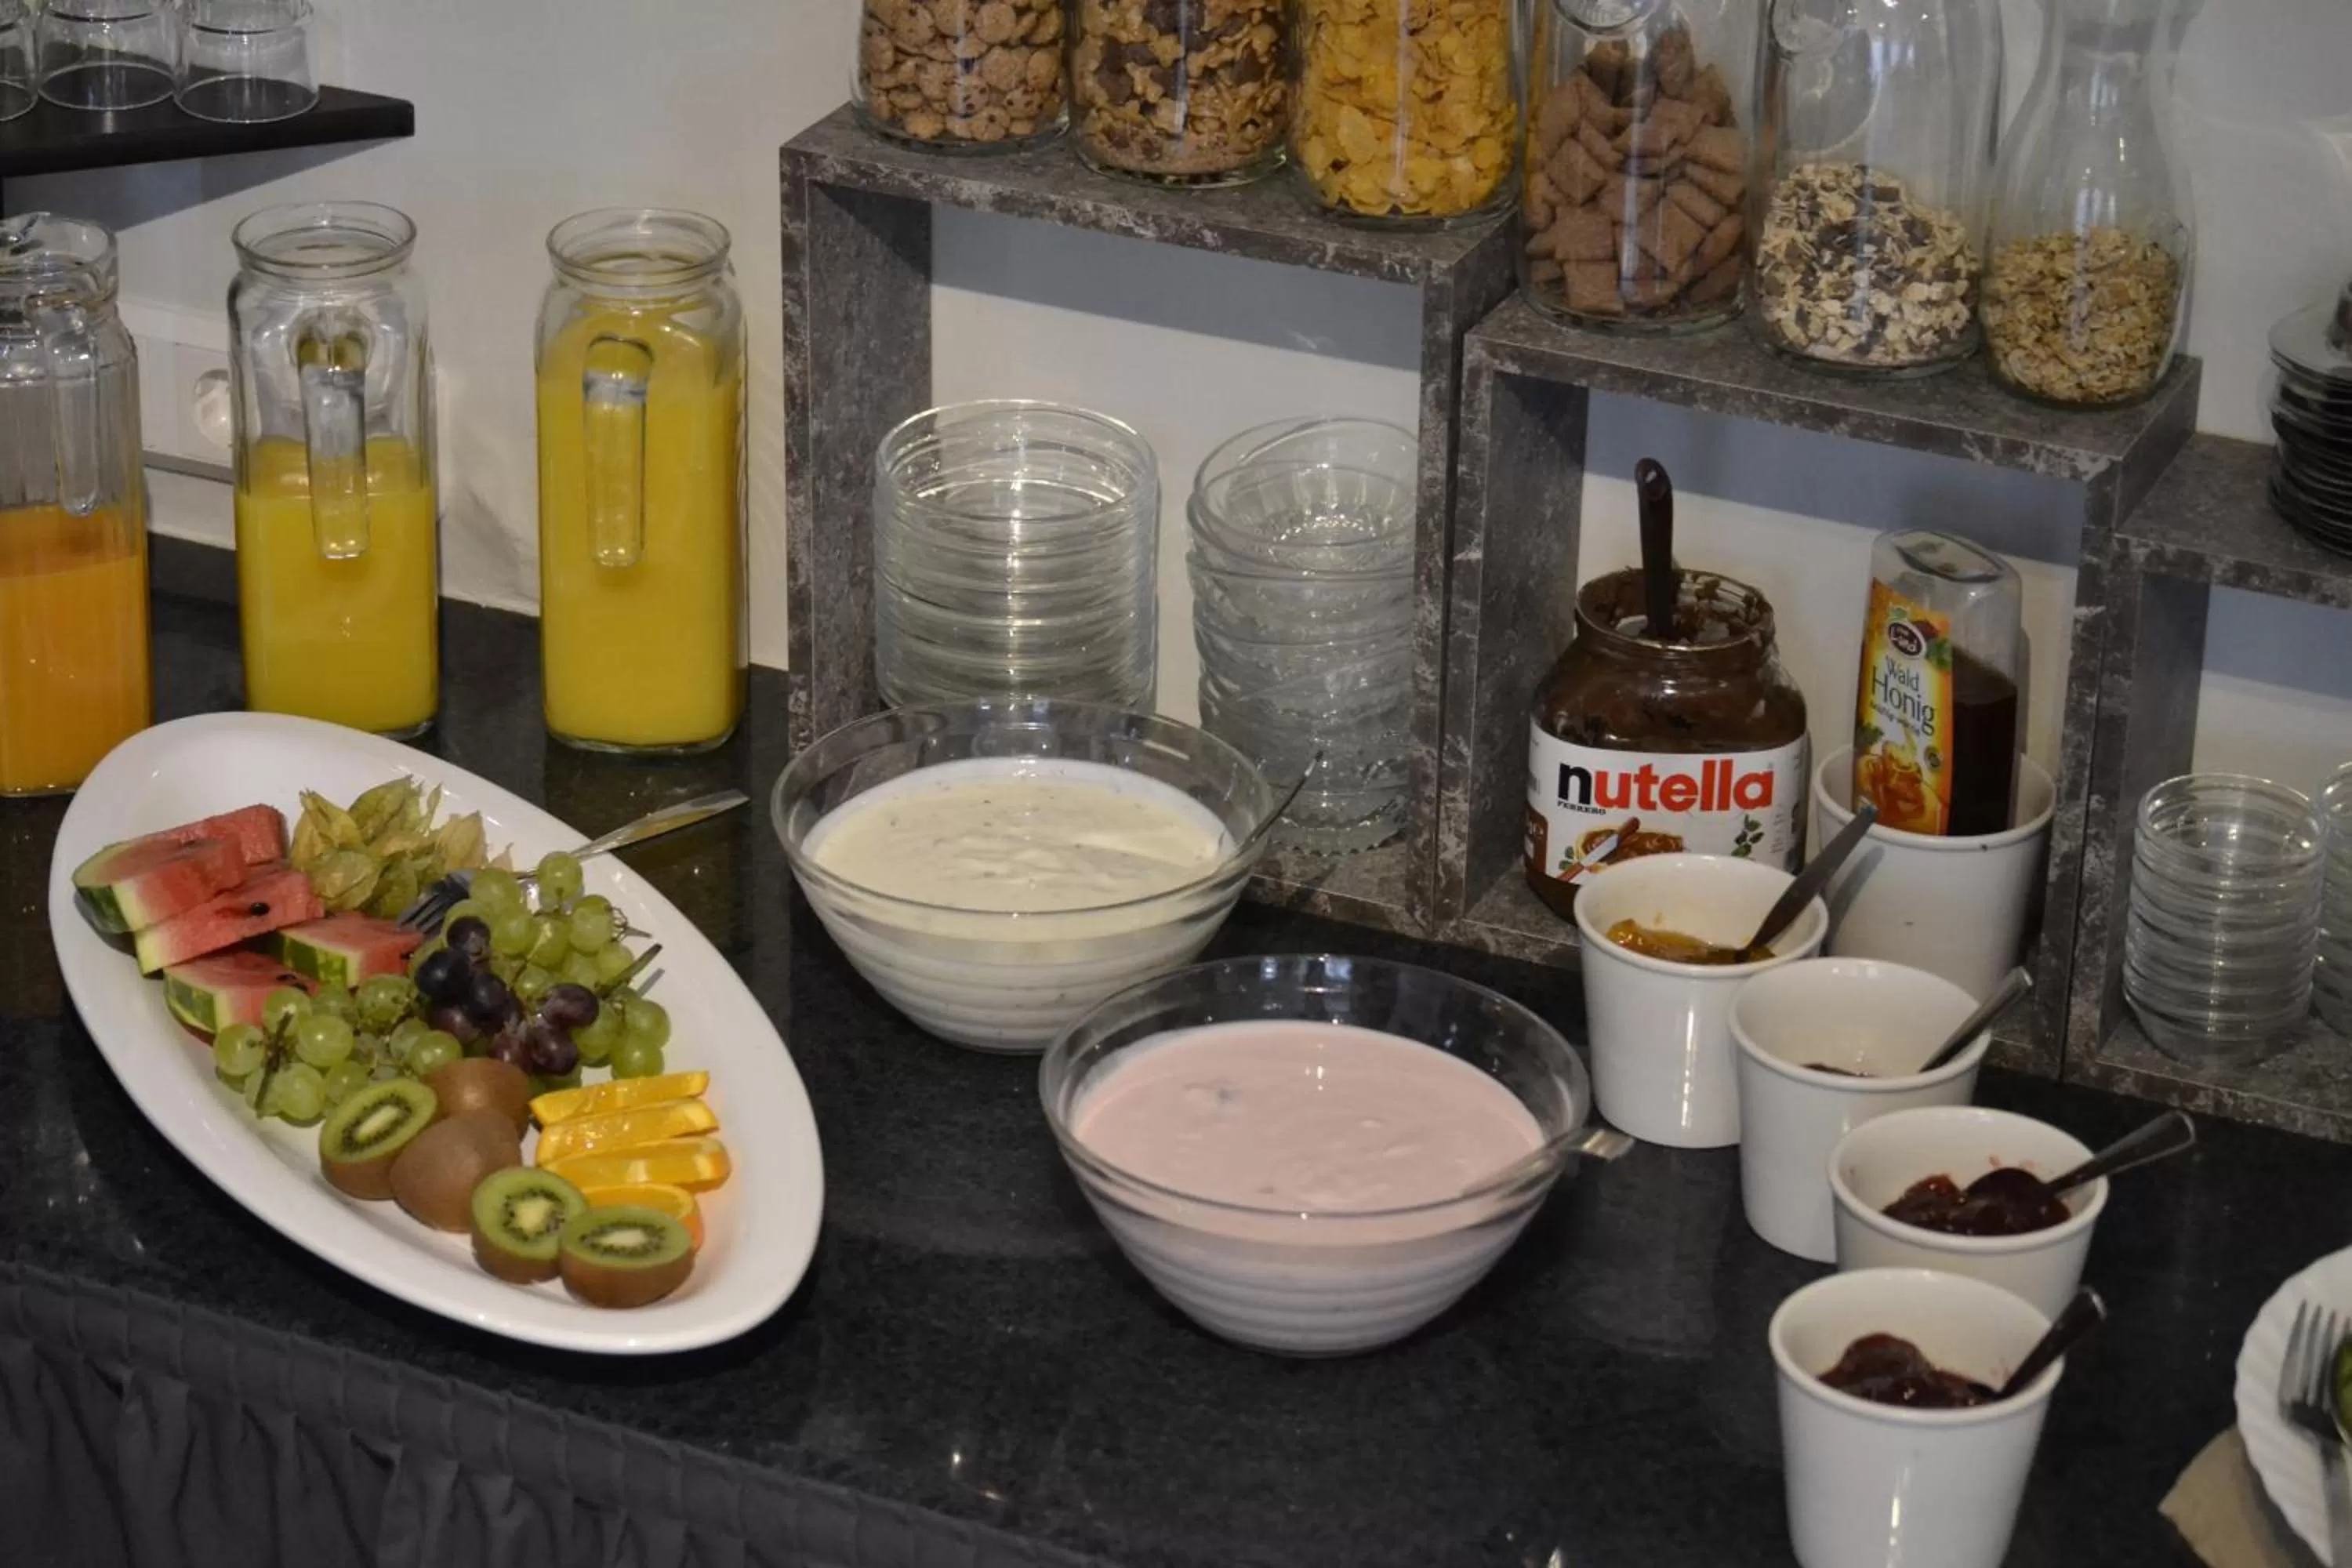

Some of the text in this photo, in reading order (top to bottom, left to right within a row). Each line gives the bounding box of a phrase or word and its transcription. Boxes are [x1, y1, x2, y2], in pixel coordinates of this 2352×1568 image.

[1886, 655, 1920, 691] Wald
[1871, 664, 1935, 736] Honig
[1558, 759, 1773, 811] nutella
[1557, 800, 1606, 815] FERRERO
